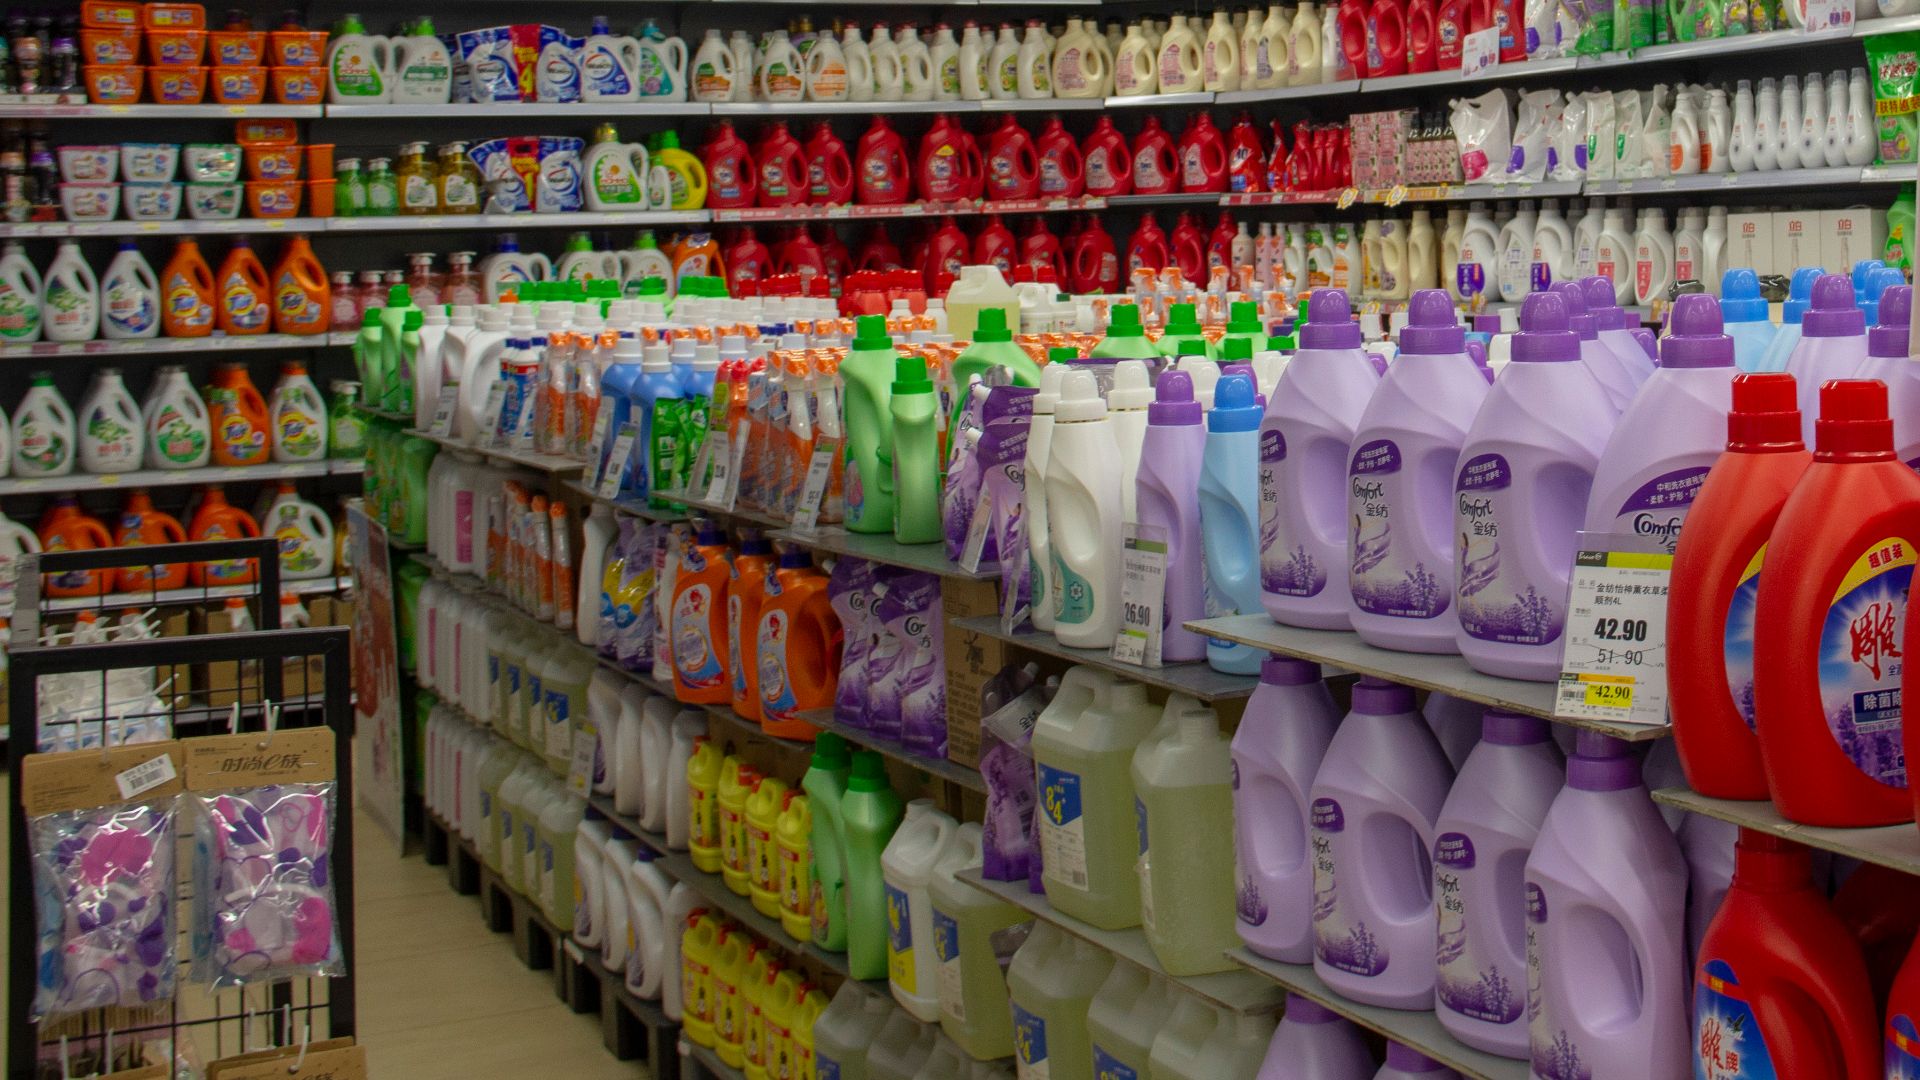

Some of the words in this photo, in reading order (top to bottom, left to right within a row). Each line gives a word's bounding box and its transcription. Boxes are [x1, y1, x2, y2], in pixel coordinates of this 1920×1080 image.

[1365, 503, 1389, 518] 金纺
[1459, 493, 1492, 523] Comfort
[1473, 521, 1498, 537] 金纺
[1124, 602, 1151, 627] 26.90
[1594, 617, 1647, 642] 42.90
[1597, 648, 1643, 666] 51.90
[1595, 685, 1630, 699] 42.90
